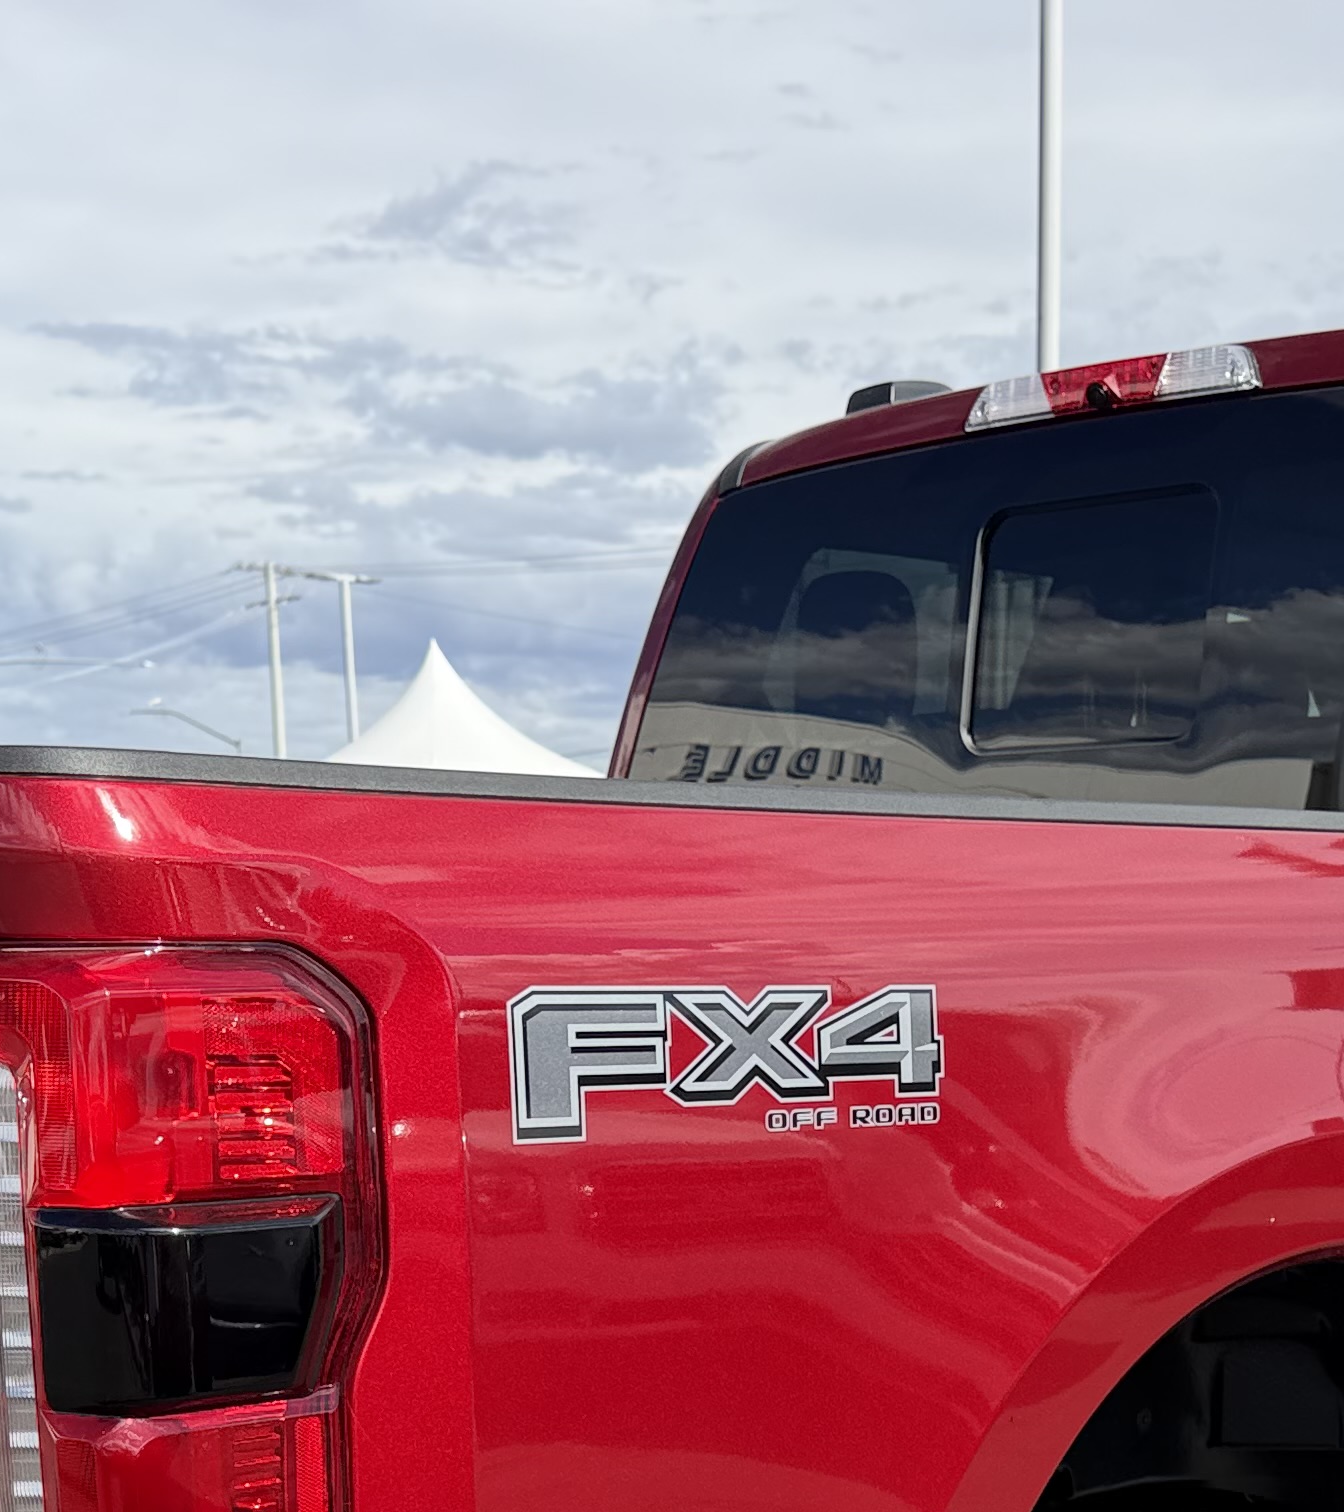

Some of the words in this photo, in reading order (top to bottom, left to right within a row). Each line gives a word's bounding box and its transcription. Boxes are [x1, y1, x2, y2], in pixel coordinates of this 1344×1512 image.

[506, 984, 945, 1145] FX4
[765, 1107, 838, 1132] OFF
[849, 1102, 941, 1129] ROAD
